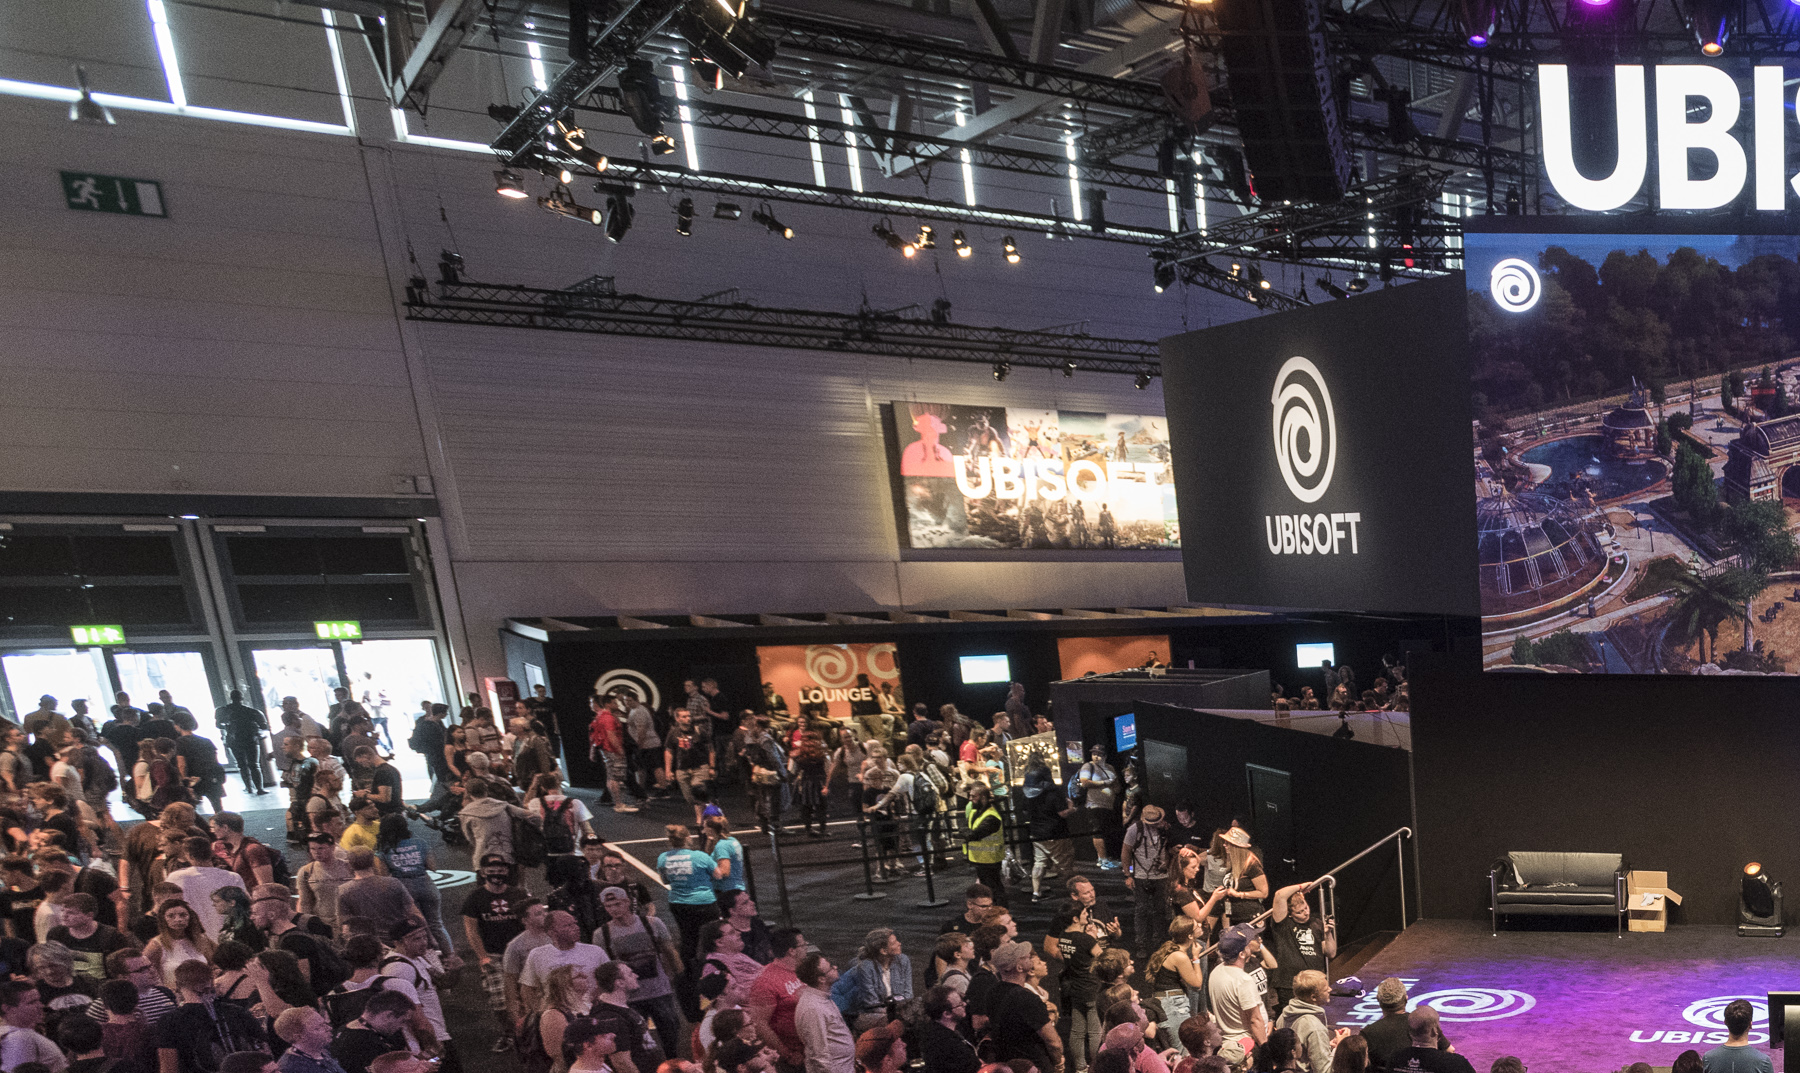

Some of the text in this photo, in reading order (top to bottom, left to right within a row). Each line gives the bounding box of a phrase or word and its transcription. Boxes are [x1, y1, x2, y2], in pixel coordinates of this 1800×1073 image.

[953, 455, 1164, 501] UBISOFT
[1266, 512, 1361, 555] UBISOFT
[798, 687, 873, 704] LOUNGE
[1628, 1030, 1770, 1044] UBISO
